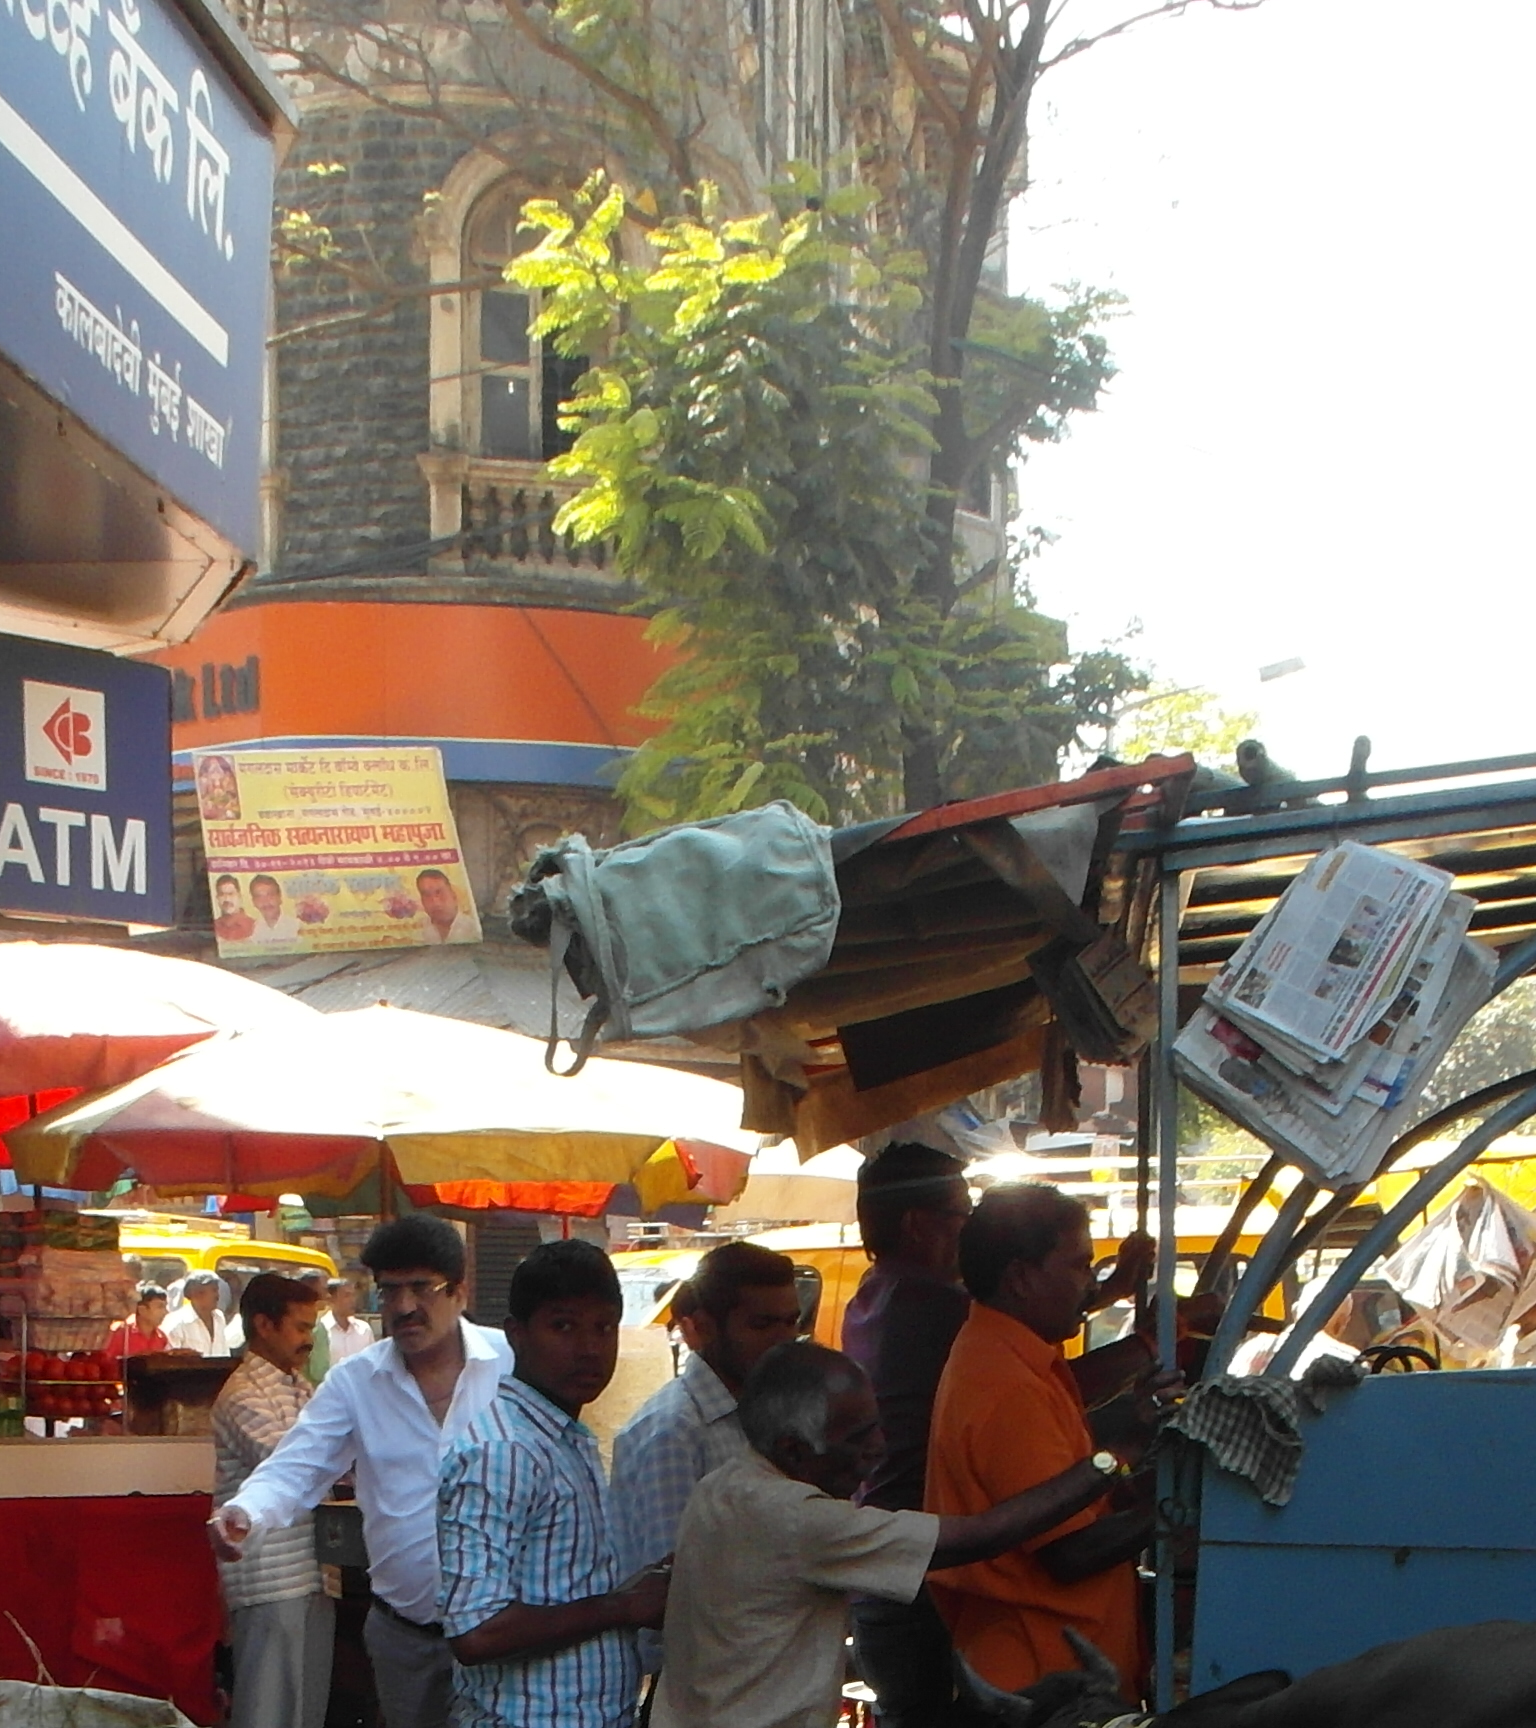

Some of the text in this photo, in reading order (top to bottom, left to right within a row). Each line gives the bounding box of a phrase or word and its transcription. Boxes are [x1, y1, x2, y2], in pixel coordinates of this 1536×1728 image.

[186, 68, 234, 262] लि.
[147, 351, 182, 443] मुंबई
[202, 655, 260, 718] Ltd
[34, 766, 65, 780] SINCE
[207, 822, 282, 848] सार्वजनिक
[285, 824, 378, 848] सत्यनारायण
